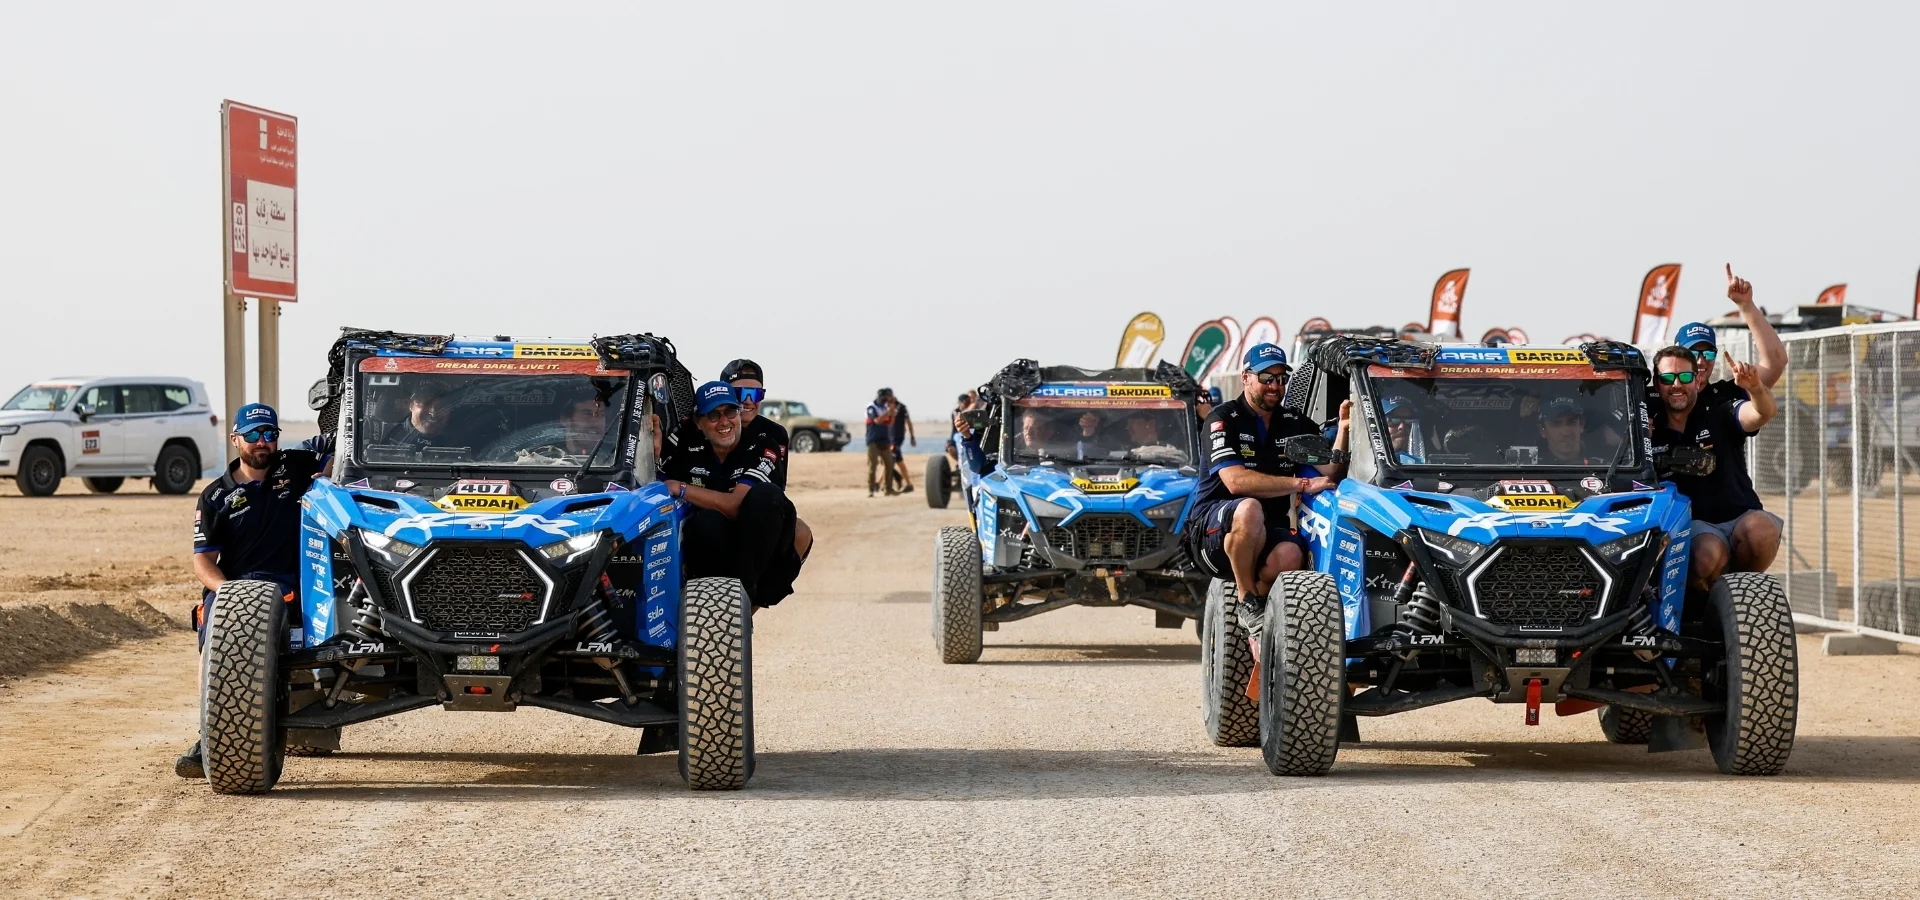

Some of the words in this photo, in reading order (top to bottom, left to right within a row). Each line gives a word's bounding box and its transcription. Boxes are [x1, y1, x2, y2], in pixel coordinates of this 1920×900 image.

[256, 197, 269, 225] رقابة
[270, 200, 286, 221] منطقة
[261, 241, 278, 266] التواجد
[444, 347, 504, 355] ARIS
[520, 347, 597, 357] BARDAH
[1437, 352, 1501, 360] ARIS
[1515, 352, 1587, 362] BARDAH
[635, 379, 646, 409] SOULTRAIT
[1030, 388, 1104, 397] POLARIS
[1110, 389, 1167, 397] BARDAHL
[633, 409, 642, 418] DE
[1363, 400, 1375, 419] HEGER
[1640, 408, 1650, 423] EDDY
[626, 433, 637, 458] BONNET
[1644, 437, 1653, 457] HEGER
[460, 484, 504, 494] 407
[556, 481, 567, 490] E
[1508, 484, 1550, 493] 401
[1586, 480, 1598, 488] E
[1410, 635, 1445, 645] LFM
[1621, 635, 1656, 646] LFM
[348, 643, 385, 654] LFM
[576, 642, 613, 653] LFM
